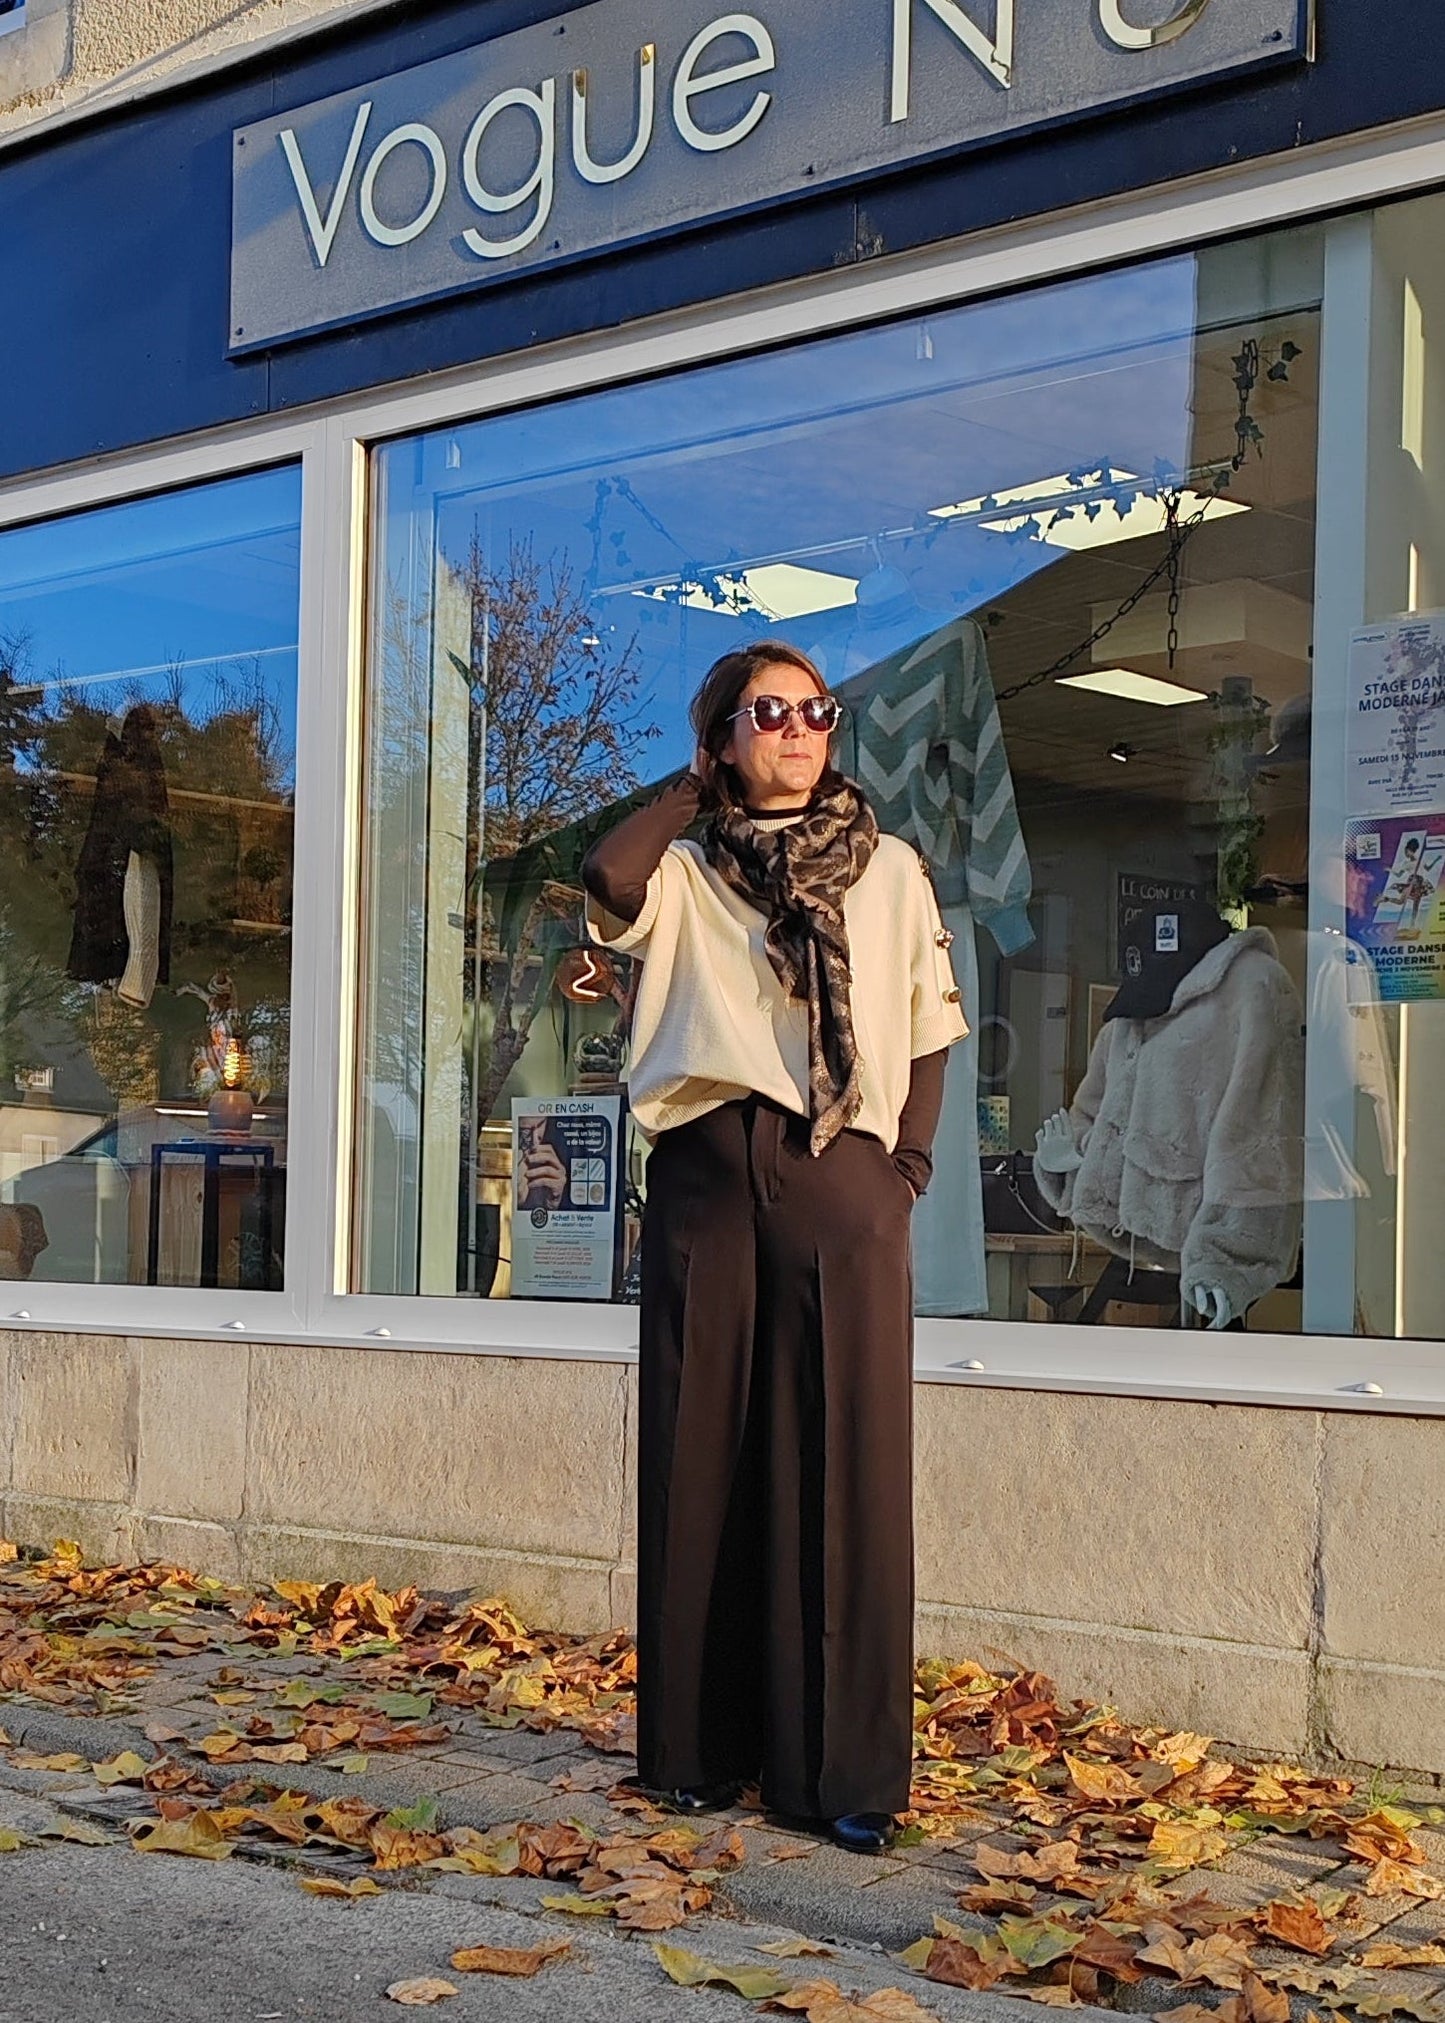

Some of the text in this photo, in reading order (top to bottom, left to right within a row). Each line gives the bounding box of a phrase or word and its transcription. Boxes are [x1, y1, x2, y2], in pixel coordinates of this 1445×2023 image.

[280, 14, 774, 259] Vogue
[1364, 680, 1407, 696] STAGE
[1359, 692, 1429, 711] MODERNE
[1359, 754, 1389, 765] SAMEDI
[1140, 884, 1170, 900] COIN
[1366, 946, 1404, 956] STAGE
[1376, 955, 1435, 967] MODERNE
[538, 1103, 594, 1113] OR EN CASH
